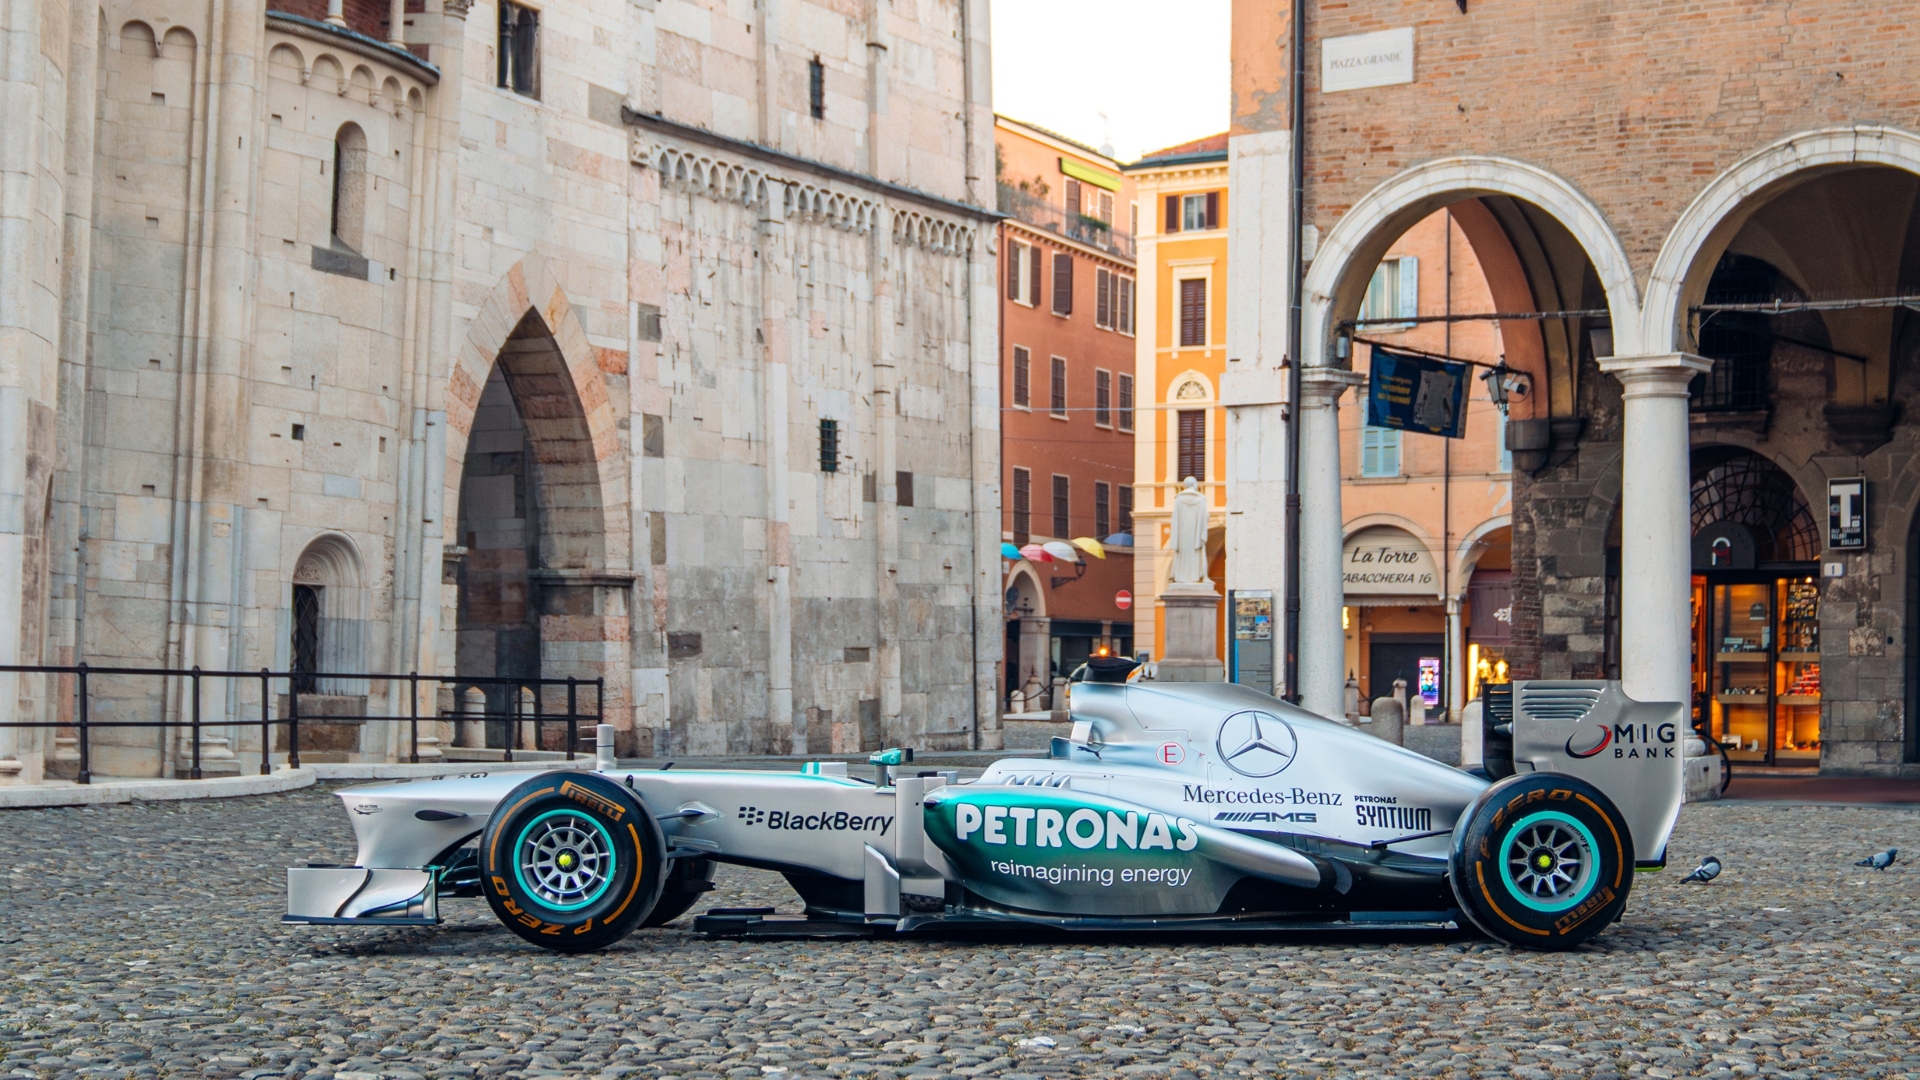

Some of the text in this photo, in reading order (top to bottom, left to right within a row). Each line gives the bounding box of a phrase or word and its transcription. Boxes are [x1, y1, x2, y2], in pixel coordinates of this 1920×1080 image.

[1330, 51, 1404, 70] PIAZZA GRANDE
[1830, 484, 1861, 528] T
[1351, 547, 1420, 564] La Torre
[1418, 572, 1432, 584] 16
[1164, 744, 1177, 763] E
[1614, 747, 1675, 759] BANK
[559, 780, 626, 822] PIRELLI
[1182, 785, 1343, 806] Mercedes-Benz
[1354, 795, 1397, 804] PETRONAS
[1249, 812, 1317, 823] AMG
[1355, 804, 1432, 831] SYNTIUM
[1491, 789, 1573, 832] ZERO
[767, 811, 894, 836] BlackBerry
[955, 802, 1198, 851] PETRONAS
[990, 860, 1193, 887] reimagining energy
[491, 876, 593, 935] P ZERO
[1554, 886, 1616, 935] PIRELLI
